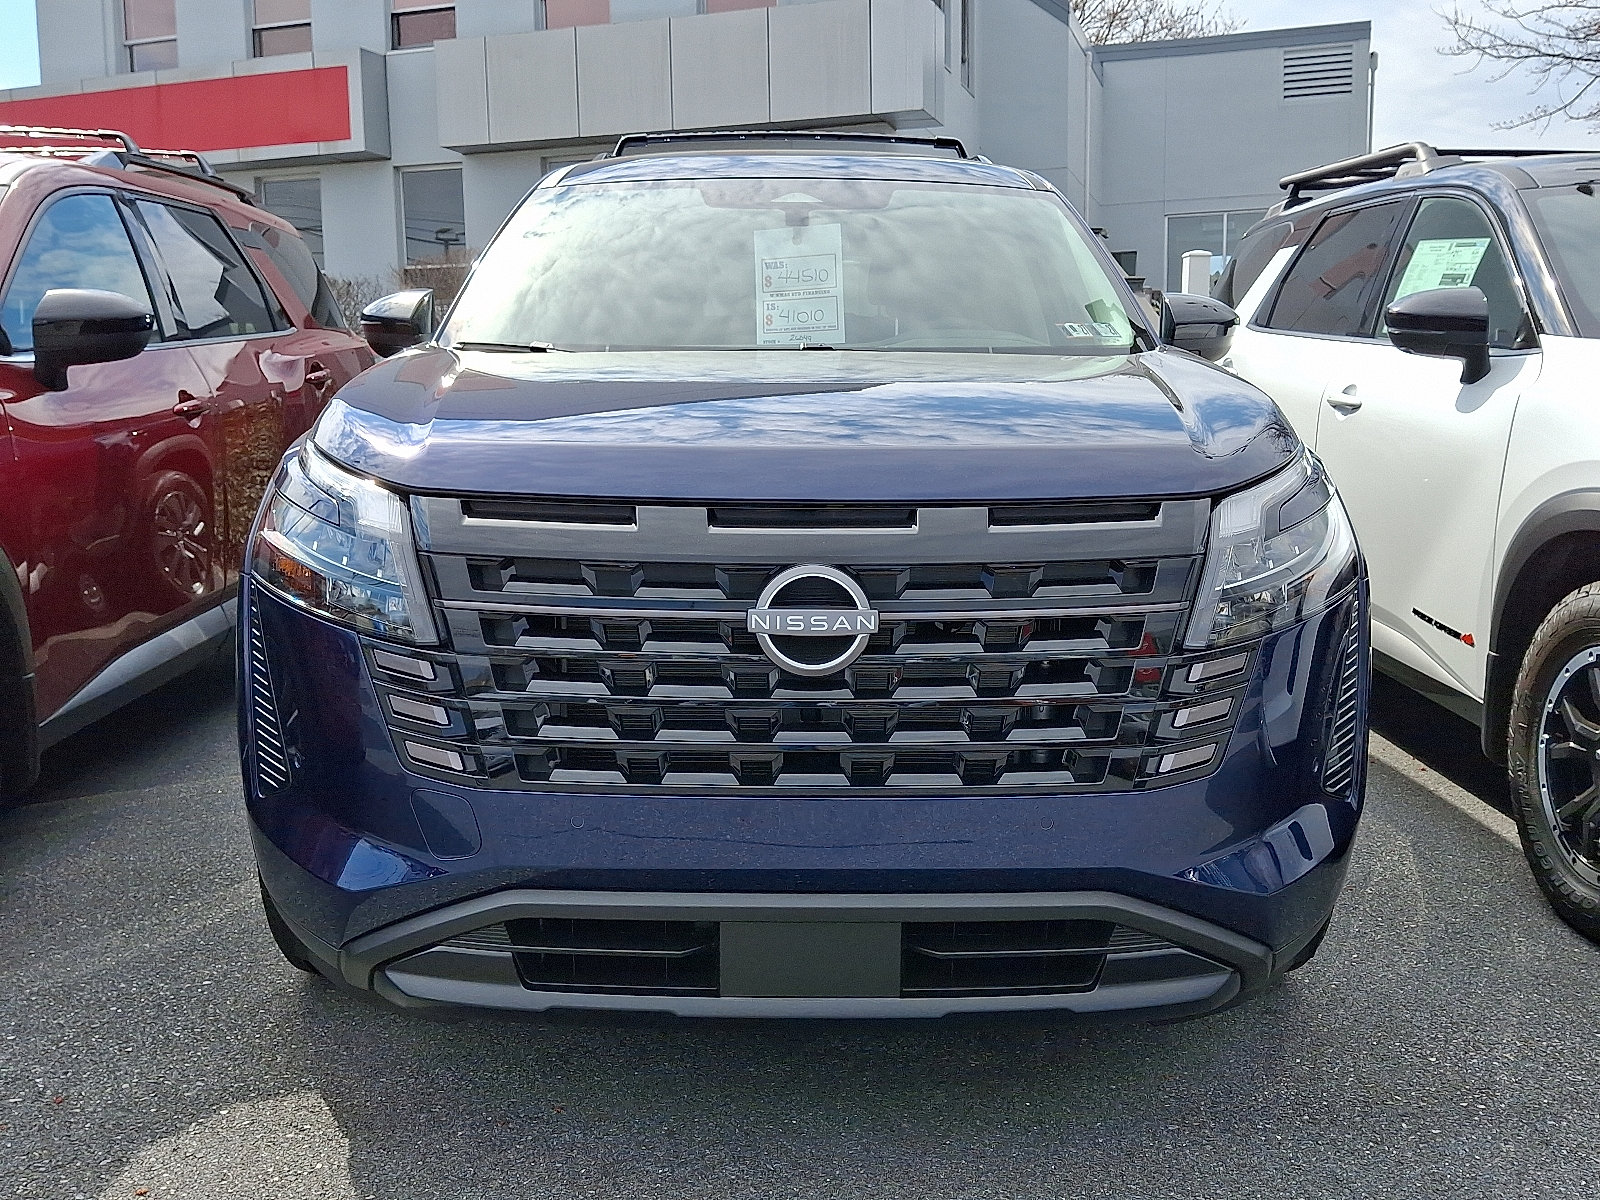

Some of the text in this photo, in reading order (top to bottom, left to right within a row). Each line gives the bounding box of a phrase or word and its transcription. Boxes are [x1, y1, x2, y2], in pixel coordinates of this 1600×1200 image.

[764, 261, 788, 270] WAS:
[777, 268, 829, 284] 44510
[766, 303, 780, 311] IS:
[778, 309, 825, 324] 41010
[751, 614, 875, 631] NISSAN
